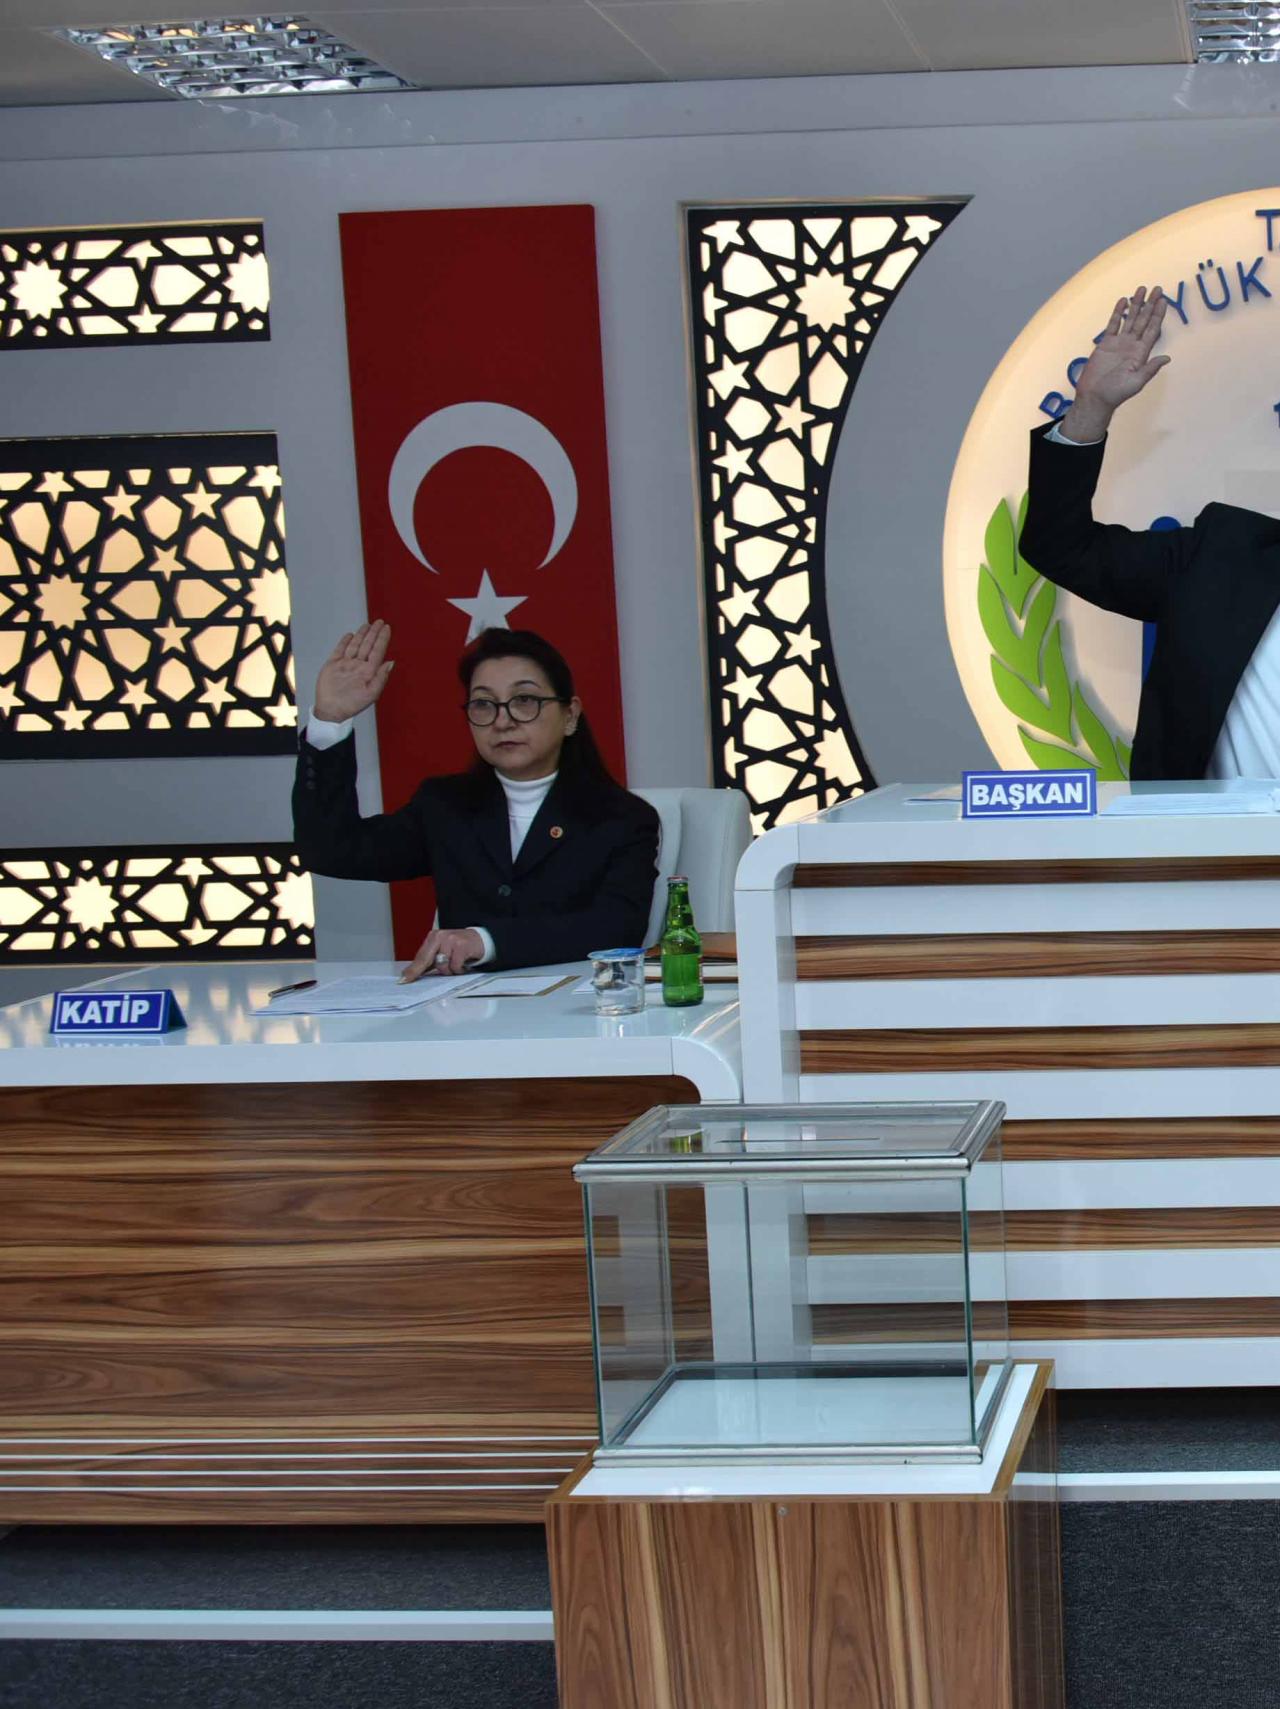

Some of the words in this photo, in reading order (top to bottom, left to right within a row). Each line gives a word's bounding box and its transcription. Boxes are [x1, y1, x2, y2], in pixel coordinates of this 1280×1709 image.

[1039, 257, 1272, 419] BYÜK
[971, 782, 1083, 811] BAŞKAN
[60, 994, 150, 1024] KATİP
